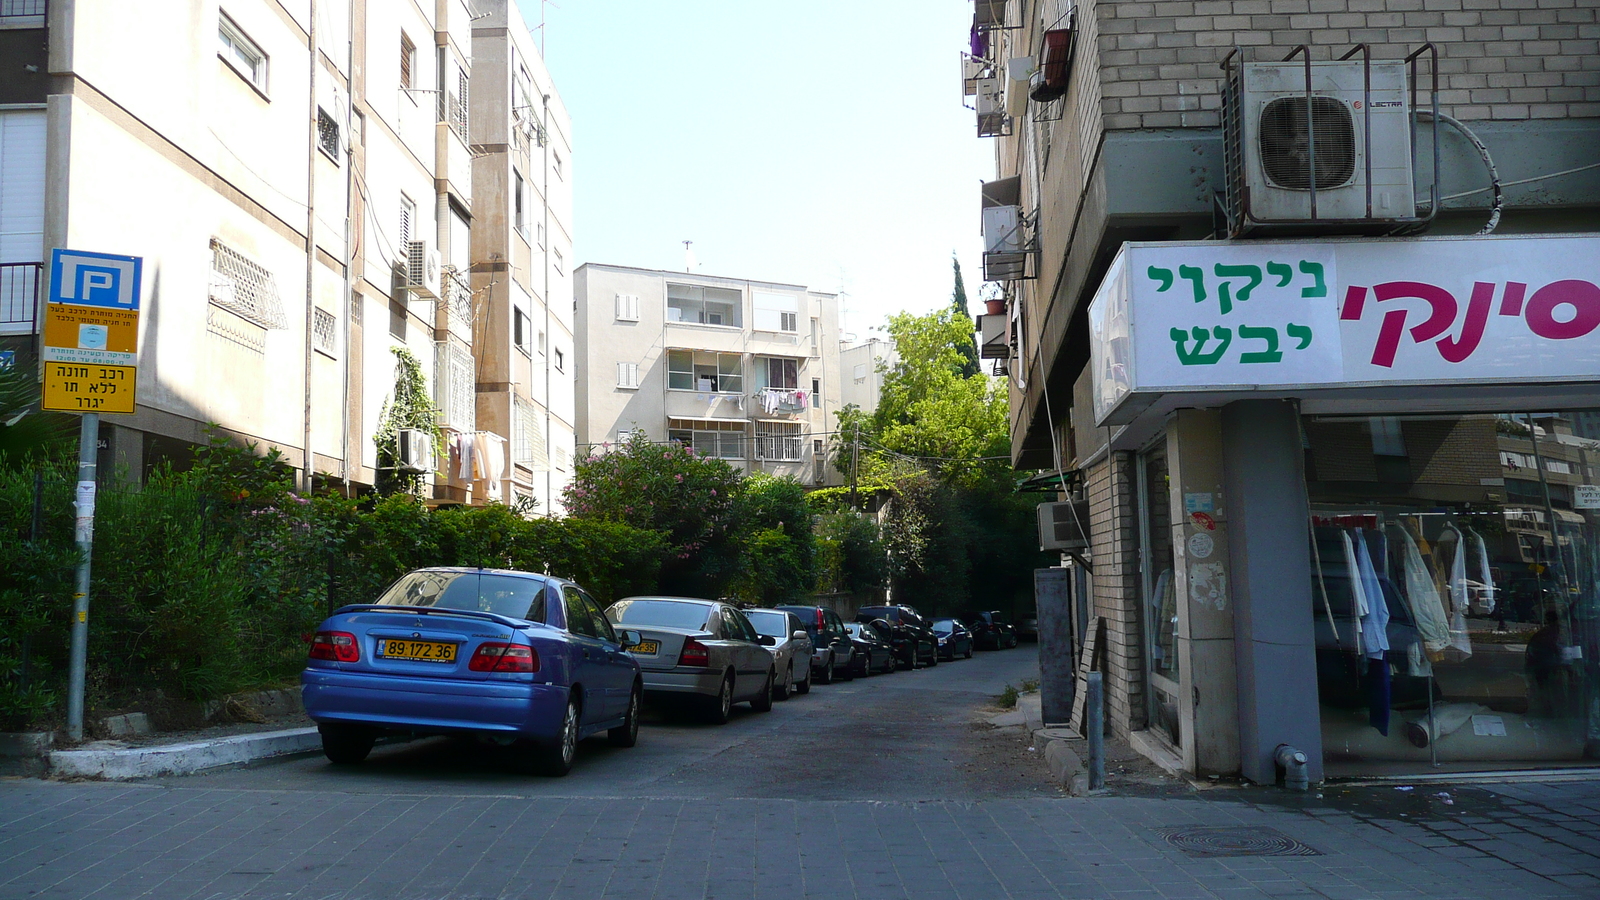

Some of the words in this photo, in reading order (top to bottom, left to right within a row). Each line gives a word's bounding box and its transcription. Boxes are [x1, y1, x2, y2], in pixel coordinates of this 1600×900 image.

[1147, 259, 1328, 315] ניקוי
[68, 307, 87, 315] לרכב
[115, 311, 138, 320] החניה
[1340, 279, 1600, 368] סינקי
[1169, 322, 1313, 366] יבש
[57, 366, 88, 378] חונה
[99, 368, 124, 380] רכב
[64, 381, 79, 392] תו
[89, 382, 117, 394] ללא
[75, 397, 104, 408] יגרר
